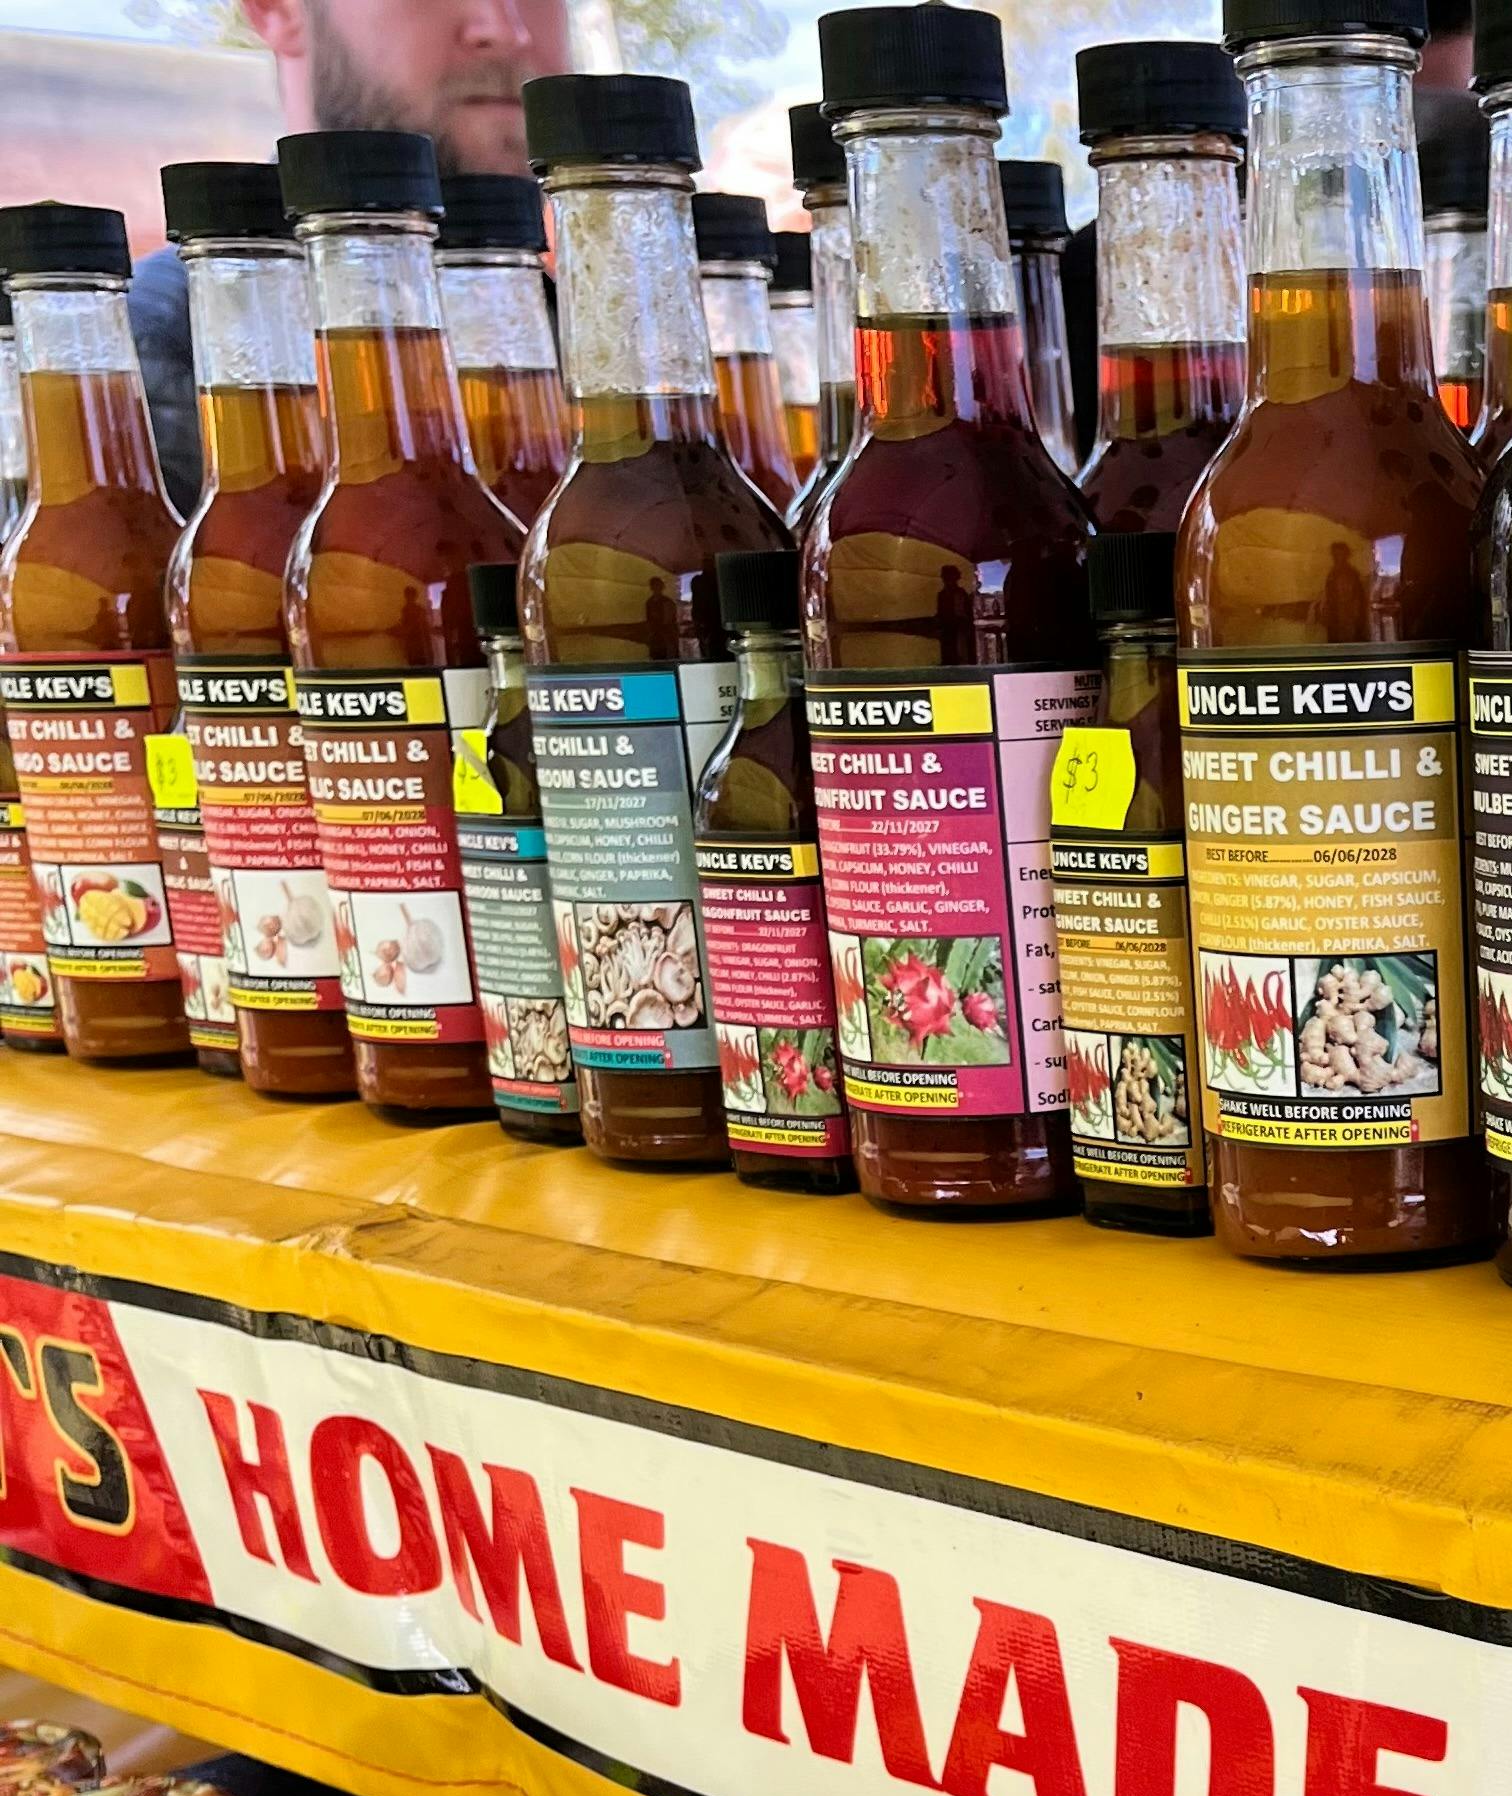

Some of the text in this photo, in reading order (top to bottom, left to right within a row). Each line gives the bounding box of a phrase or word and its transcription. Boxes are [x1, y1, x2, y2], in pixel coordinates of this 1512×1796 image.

[36, 678, 112, 699] KEV'S
[206, 679, 288, 702] KEV'S
[1188, 681, 1412, 716] UNCLE KEV'S
[327, 691, 406, 716] KEV'S
[552, 688, 624, 711] KEV'S
[849, 699, 932, 725] KEV'S
[32, 719, 134, 740] CHILLI &
[204, 726, 277, 746] CHILLI
[322, 740, 429, 762] CHILLI &
[548, 736, 633, 756] CHILLI &
[49, 752, 130, 772] SAUCE
[219, 761, 303, 782] SAUCE
[839, 752, 942, 774] CHILLI &
[1183, 747, 1442, 782] SWEET CHILLI &
[580, 768, 657, 787] SAUCE
[1062, 748, 1099, 804] $3
[339, 777, 424, 799] SAUCE
[893, 788, 987, 810] SAUCE
[1189, 801, 1436, 835] GINGER SAUCE
[742, 853, 792, 870] KEV'S
[1100, 853, 1147, 870] KEV'S
[735, 889, 775, 901] CHILLI
[765, 909, 810, 921] SAUCE
[1104, 917, 1159, 934] SAUCE
[1250, 1104, 1411, 1120] WELL BEFORE OPENING
[1294, 1126, 1410, 1141] AFTER OPENING
[197, 1387, 682, 1708] HOME
